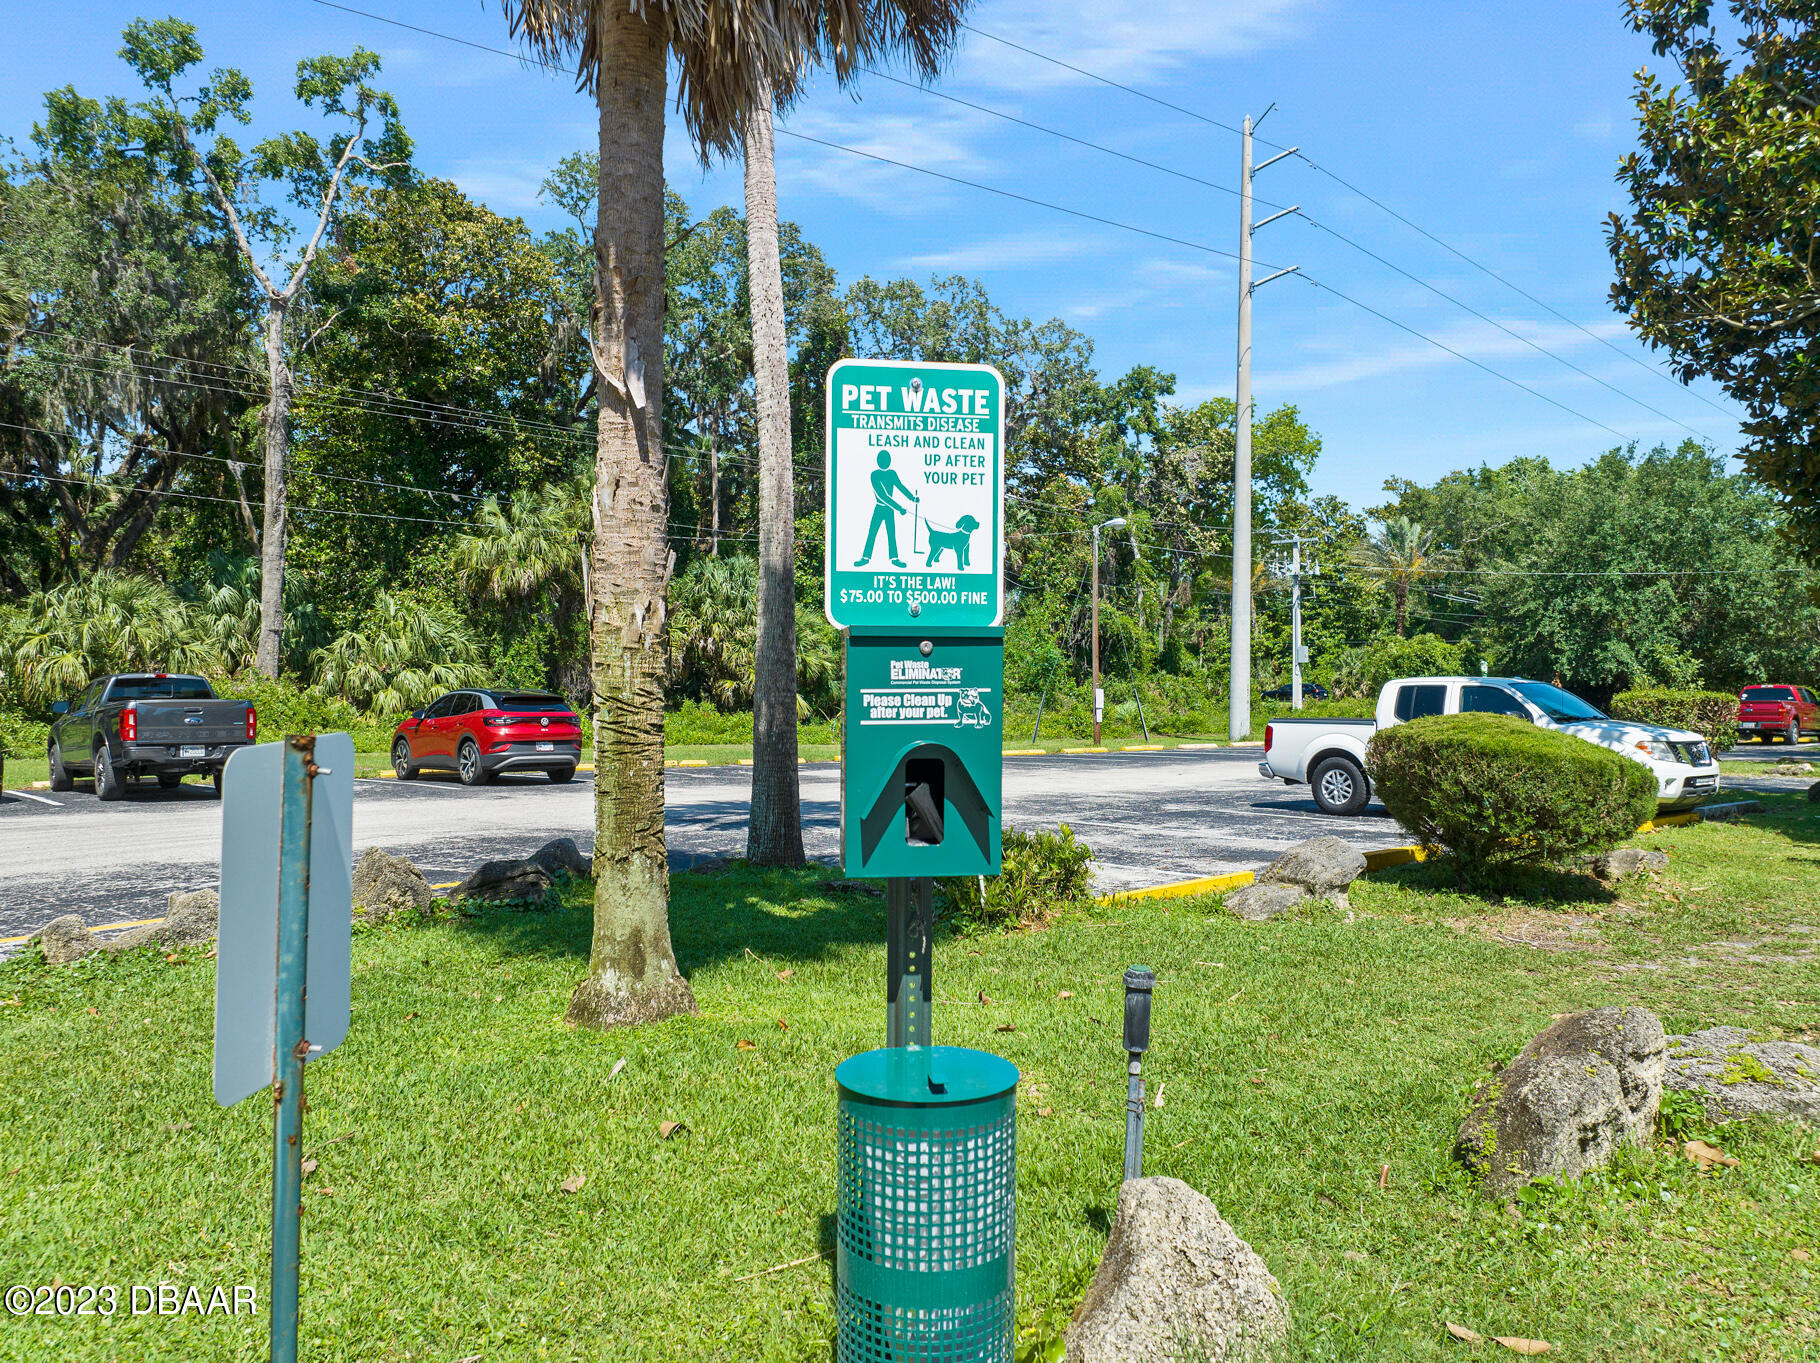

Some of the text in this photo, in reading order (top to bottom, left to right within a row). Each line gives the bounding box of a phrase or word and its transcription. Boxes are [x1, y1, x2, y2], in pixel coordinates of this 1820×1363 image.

[842, 384, 990, 414] PET WASTE
[851, 414, 980, 432] TRANSMITS DISEASE
[868, 434, 985, 450] LEASH AND CLEAN
[924, 454, 985, 468] UP AFTER
[924, 472, 985, 485] YOUR PET
[873, 575, 956, 589] IT'S THE LAW!
[840, 588, 988, 605] $75.00 TO $500.00 FINE
[890, 660, 930, 669] Pet Waste
[862, 694, 953, 707] Please Clean Up
[870, 706, 948, 719] after your pet.
